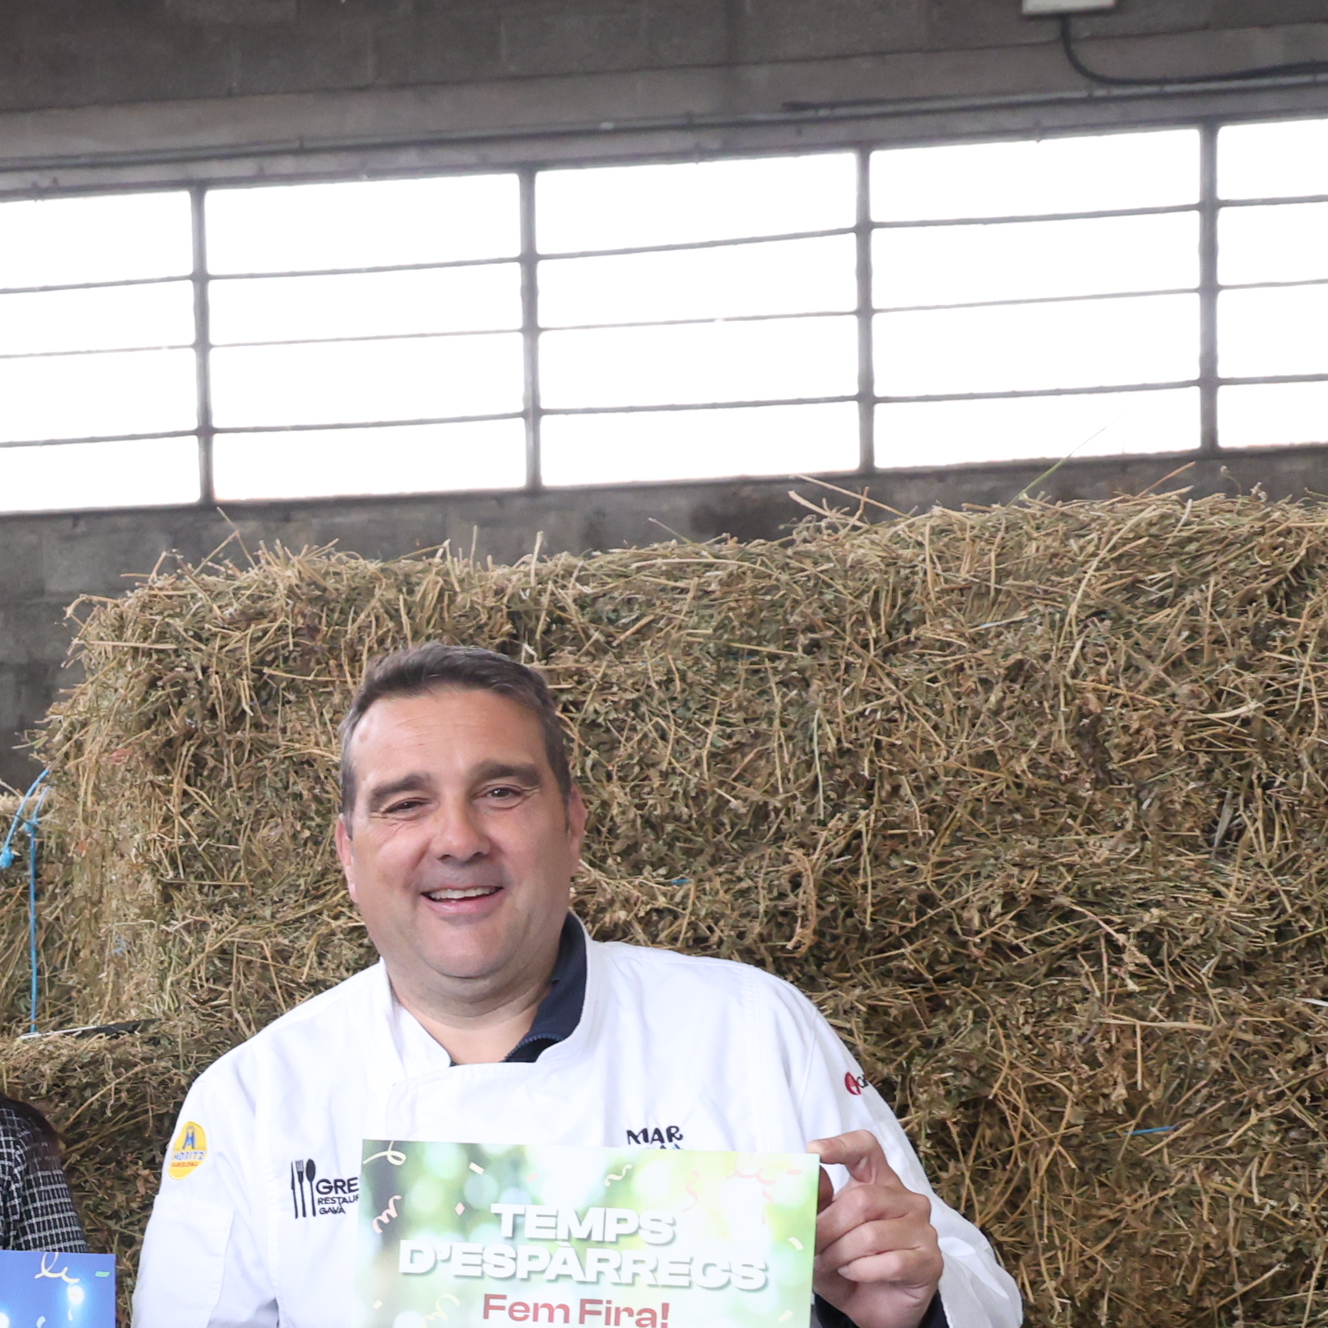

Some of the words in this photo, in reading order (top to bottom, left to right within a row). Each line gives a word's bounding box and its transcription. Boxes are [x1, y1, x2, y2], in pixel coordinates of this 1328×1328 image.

[626, 1125, 684, 1145] MAR
[490, 1203, 676, 1245] TEMPS
[483, 1293, 570, 1324] Fem
[578, 1298, 670, 1328] Fira!
